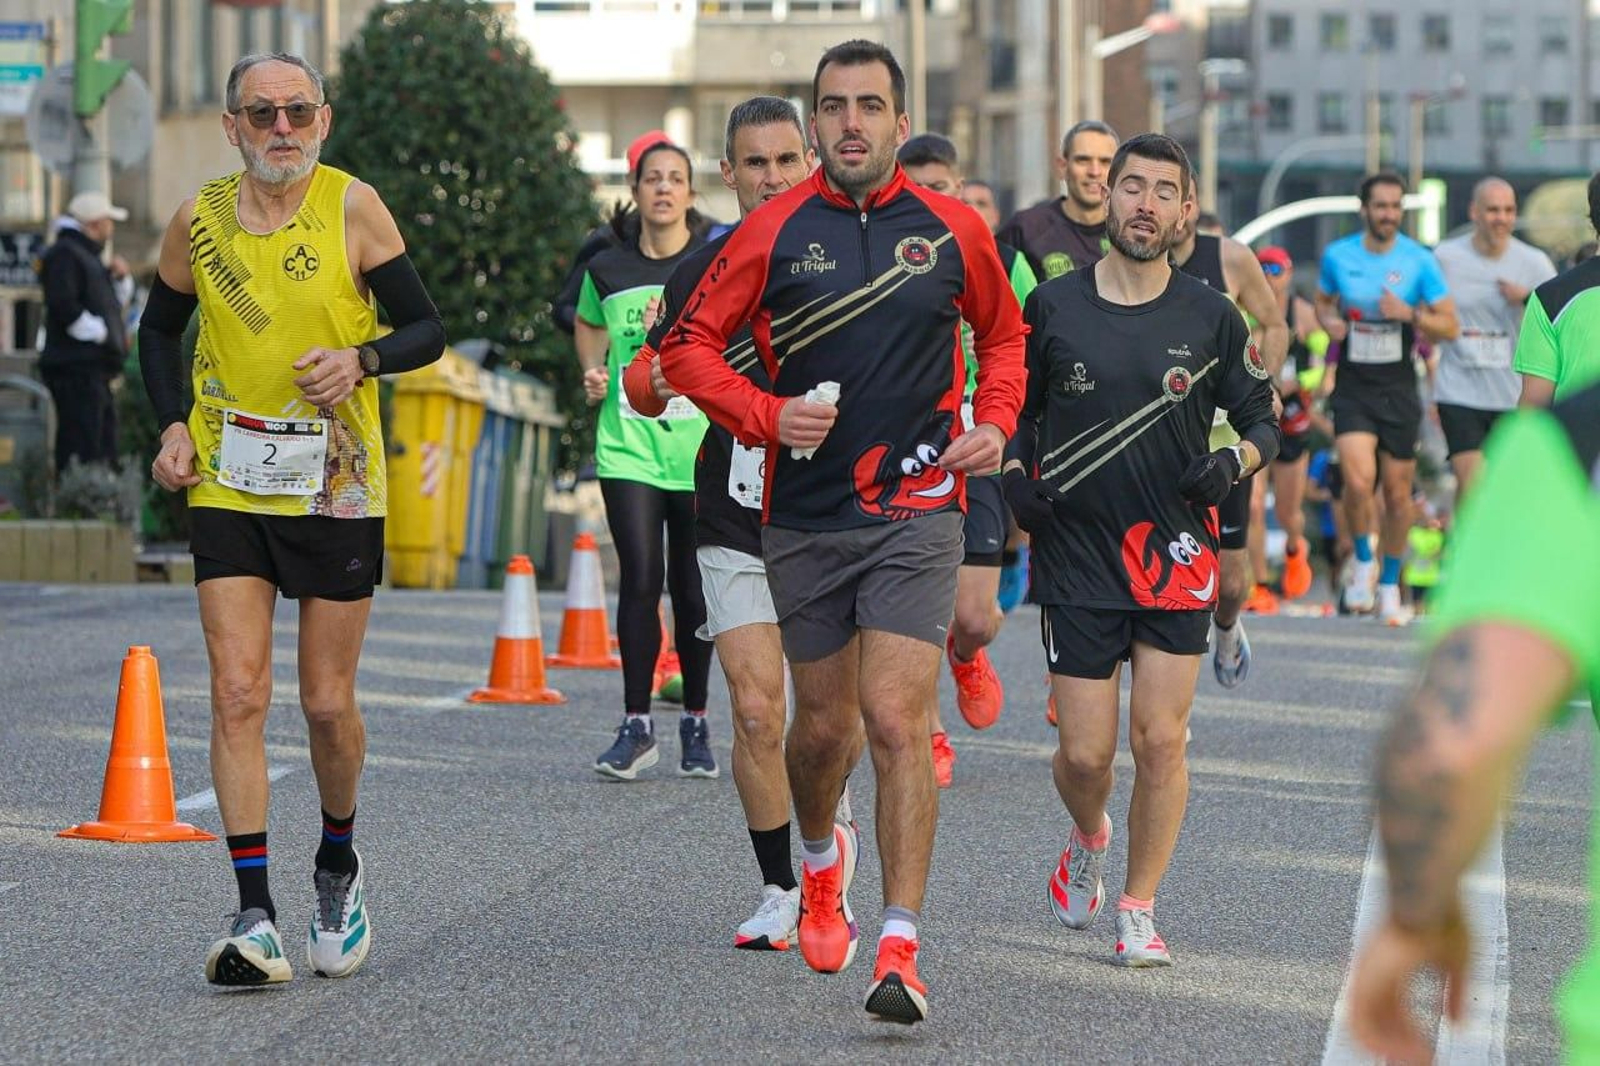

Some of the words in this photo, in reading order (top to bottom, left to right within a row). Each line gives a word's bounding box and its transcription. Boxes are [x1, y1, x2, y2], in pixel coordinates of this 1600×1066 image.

[801, 259, 836, 273] Trigal
[1070, 379, 1095, 393] Trigal
[262, 443, 277, 466] 2
